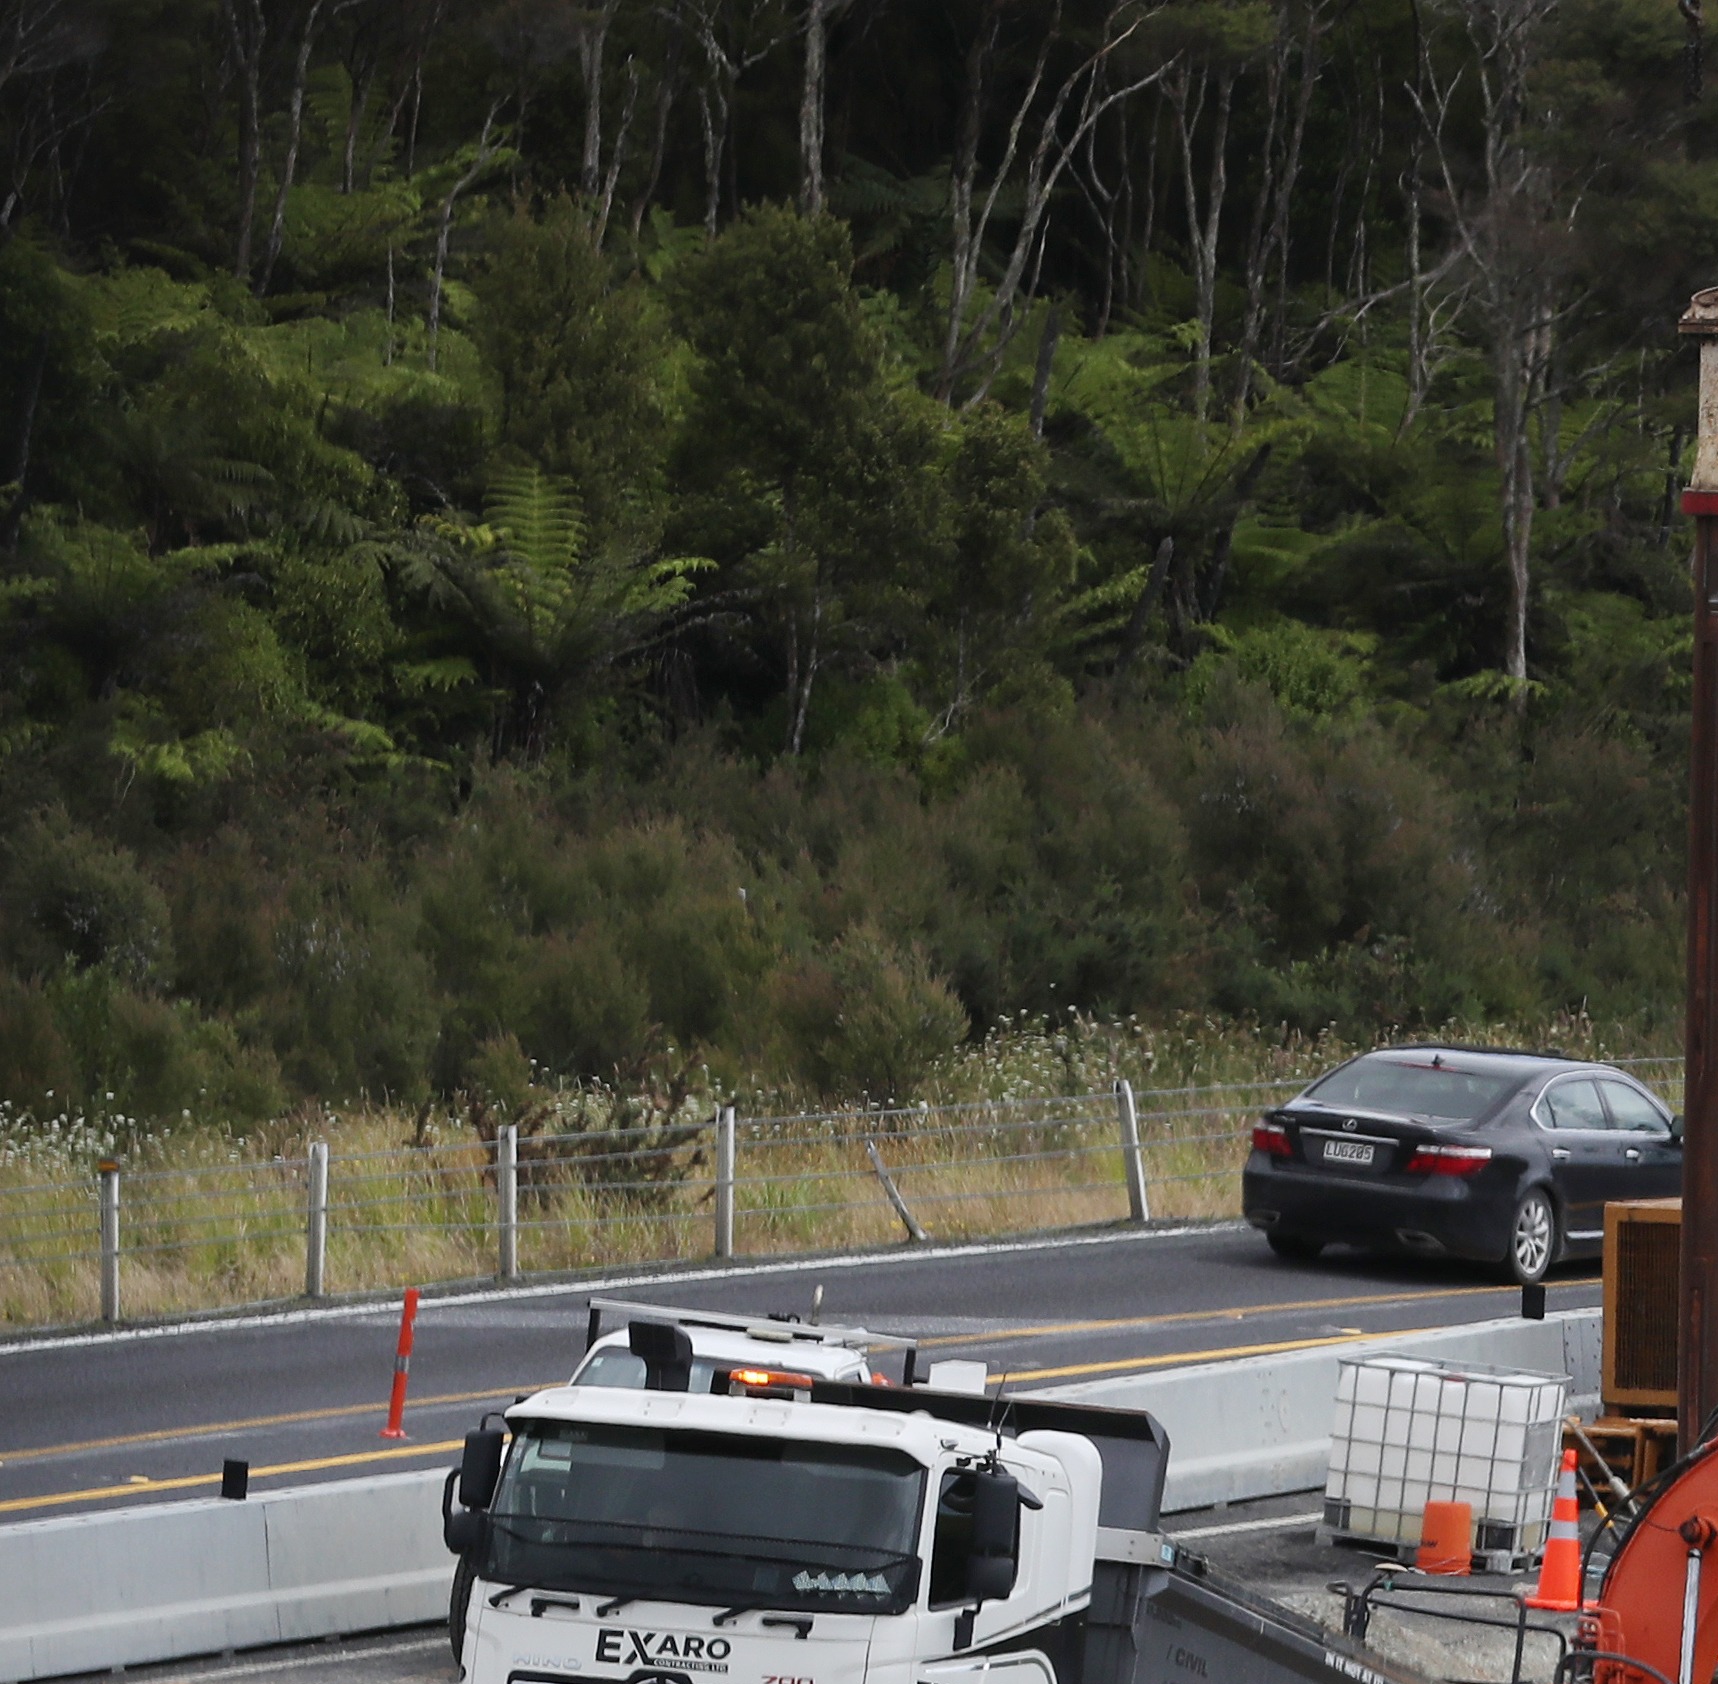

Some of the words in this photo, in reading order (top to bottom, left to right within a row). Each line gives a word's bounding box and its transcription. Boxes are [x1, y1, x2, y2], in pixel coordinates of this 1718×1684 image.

[595, 1628, 731, 1666] EXARO
[1175, 1647, 1208, 1678] CIVIL
[653, 1658, 707, 1672] CONTRACTING
